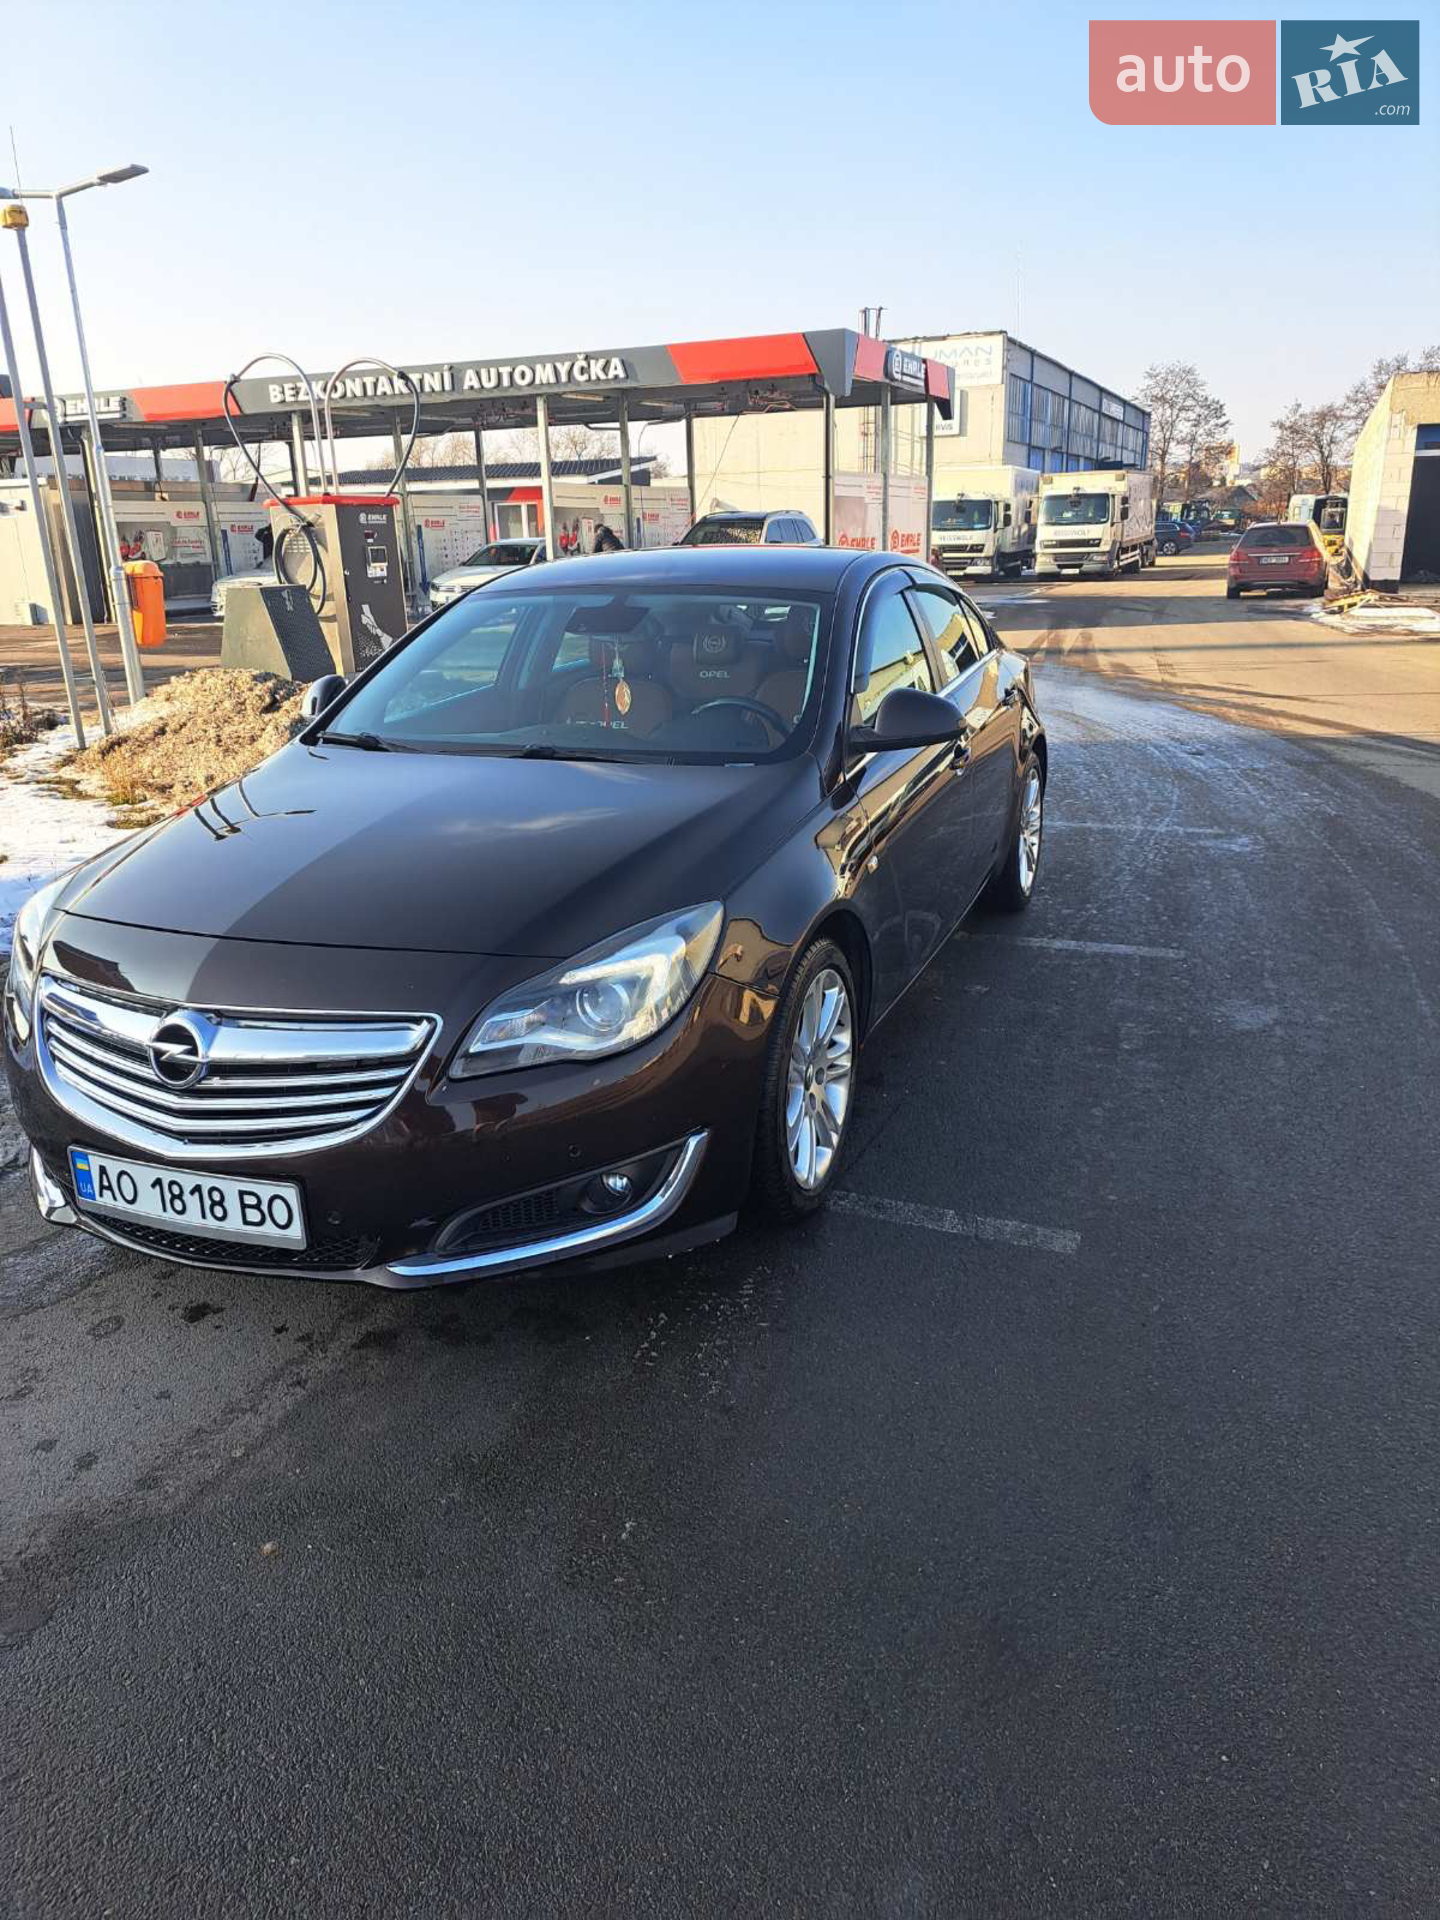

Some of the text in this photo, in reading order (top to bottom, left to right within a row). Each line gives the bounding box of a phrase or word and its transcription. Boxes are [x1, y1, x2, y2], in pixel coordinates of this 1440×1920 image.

[268, 353, 626, 403] BEZKONTAKTNÍ AUTOMYČKA
[700, 670, 730, 679] OPEL
[150, 1177, 228, 1222] 1818
